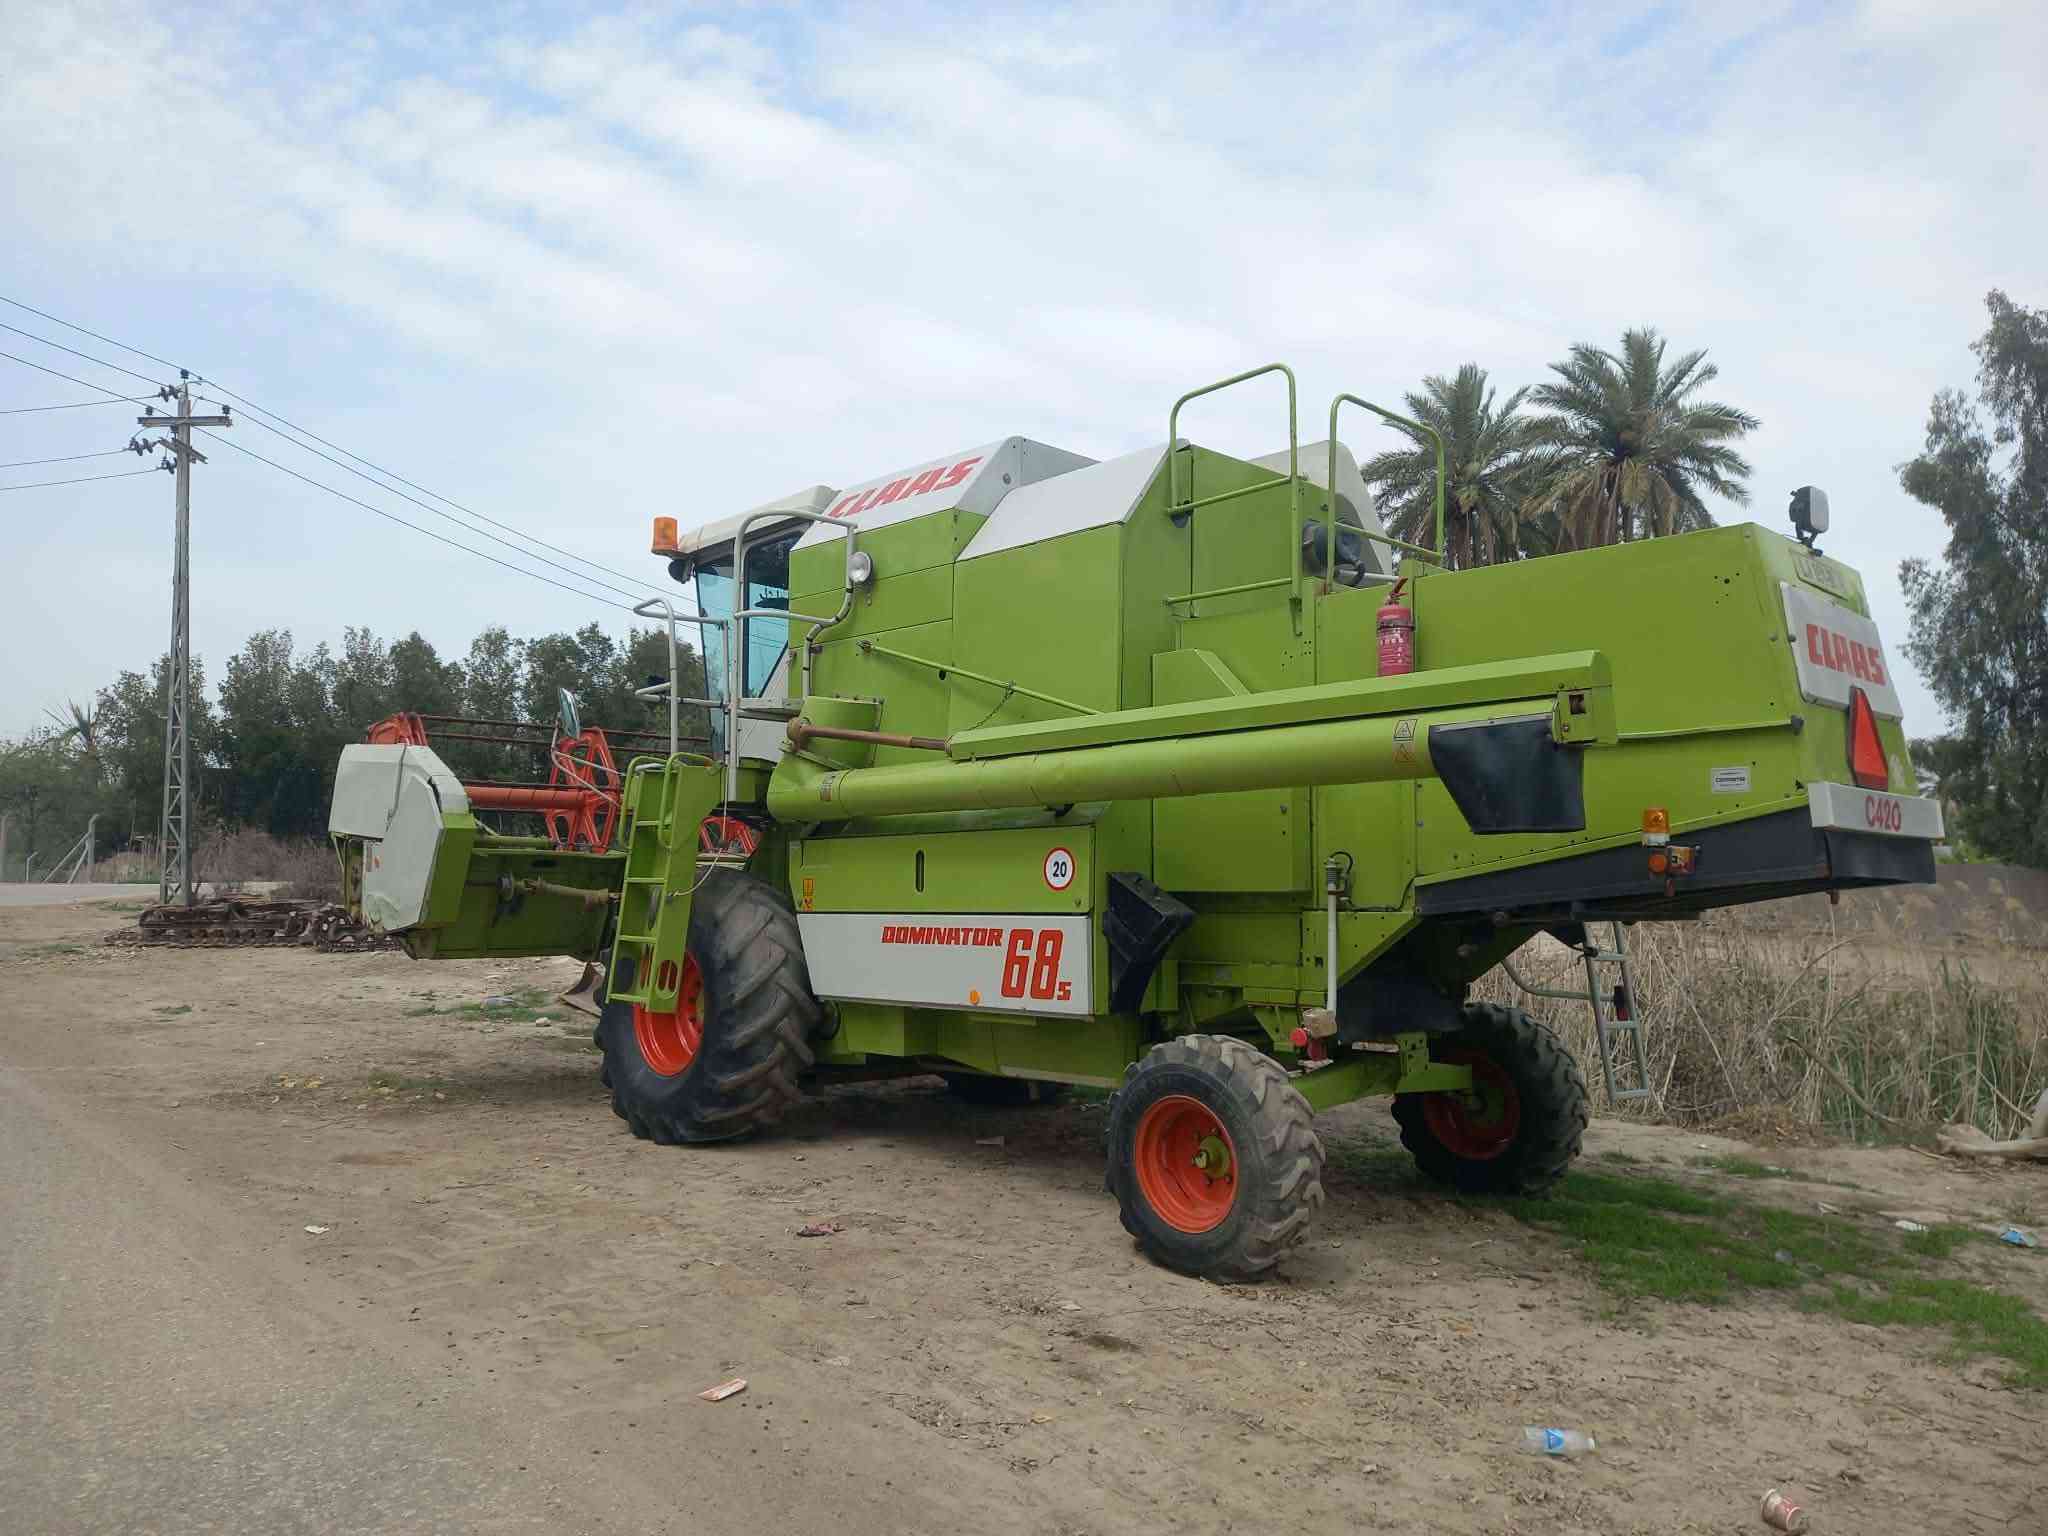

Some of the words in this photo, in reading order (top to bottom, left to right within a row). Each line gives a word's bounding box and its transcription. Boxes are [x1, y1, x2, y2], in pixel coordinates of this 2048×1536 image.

[829, 456, 984, 517] CLAAS
[1806, 623, 1886, 686] CLAAS
[1865, 795, 1902, 832] C420
[1053, 861, 1067, 878] 20
[881, 926, 1002, 947] DOMINATOR
